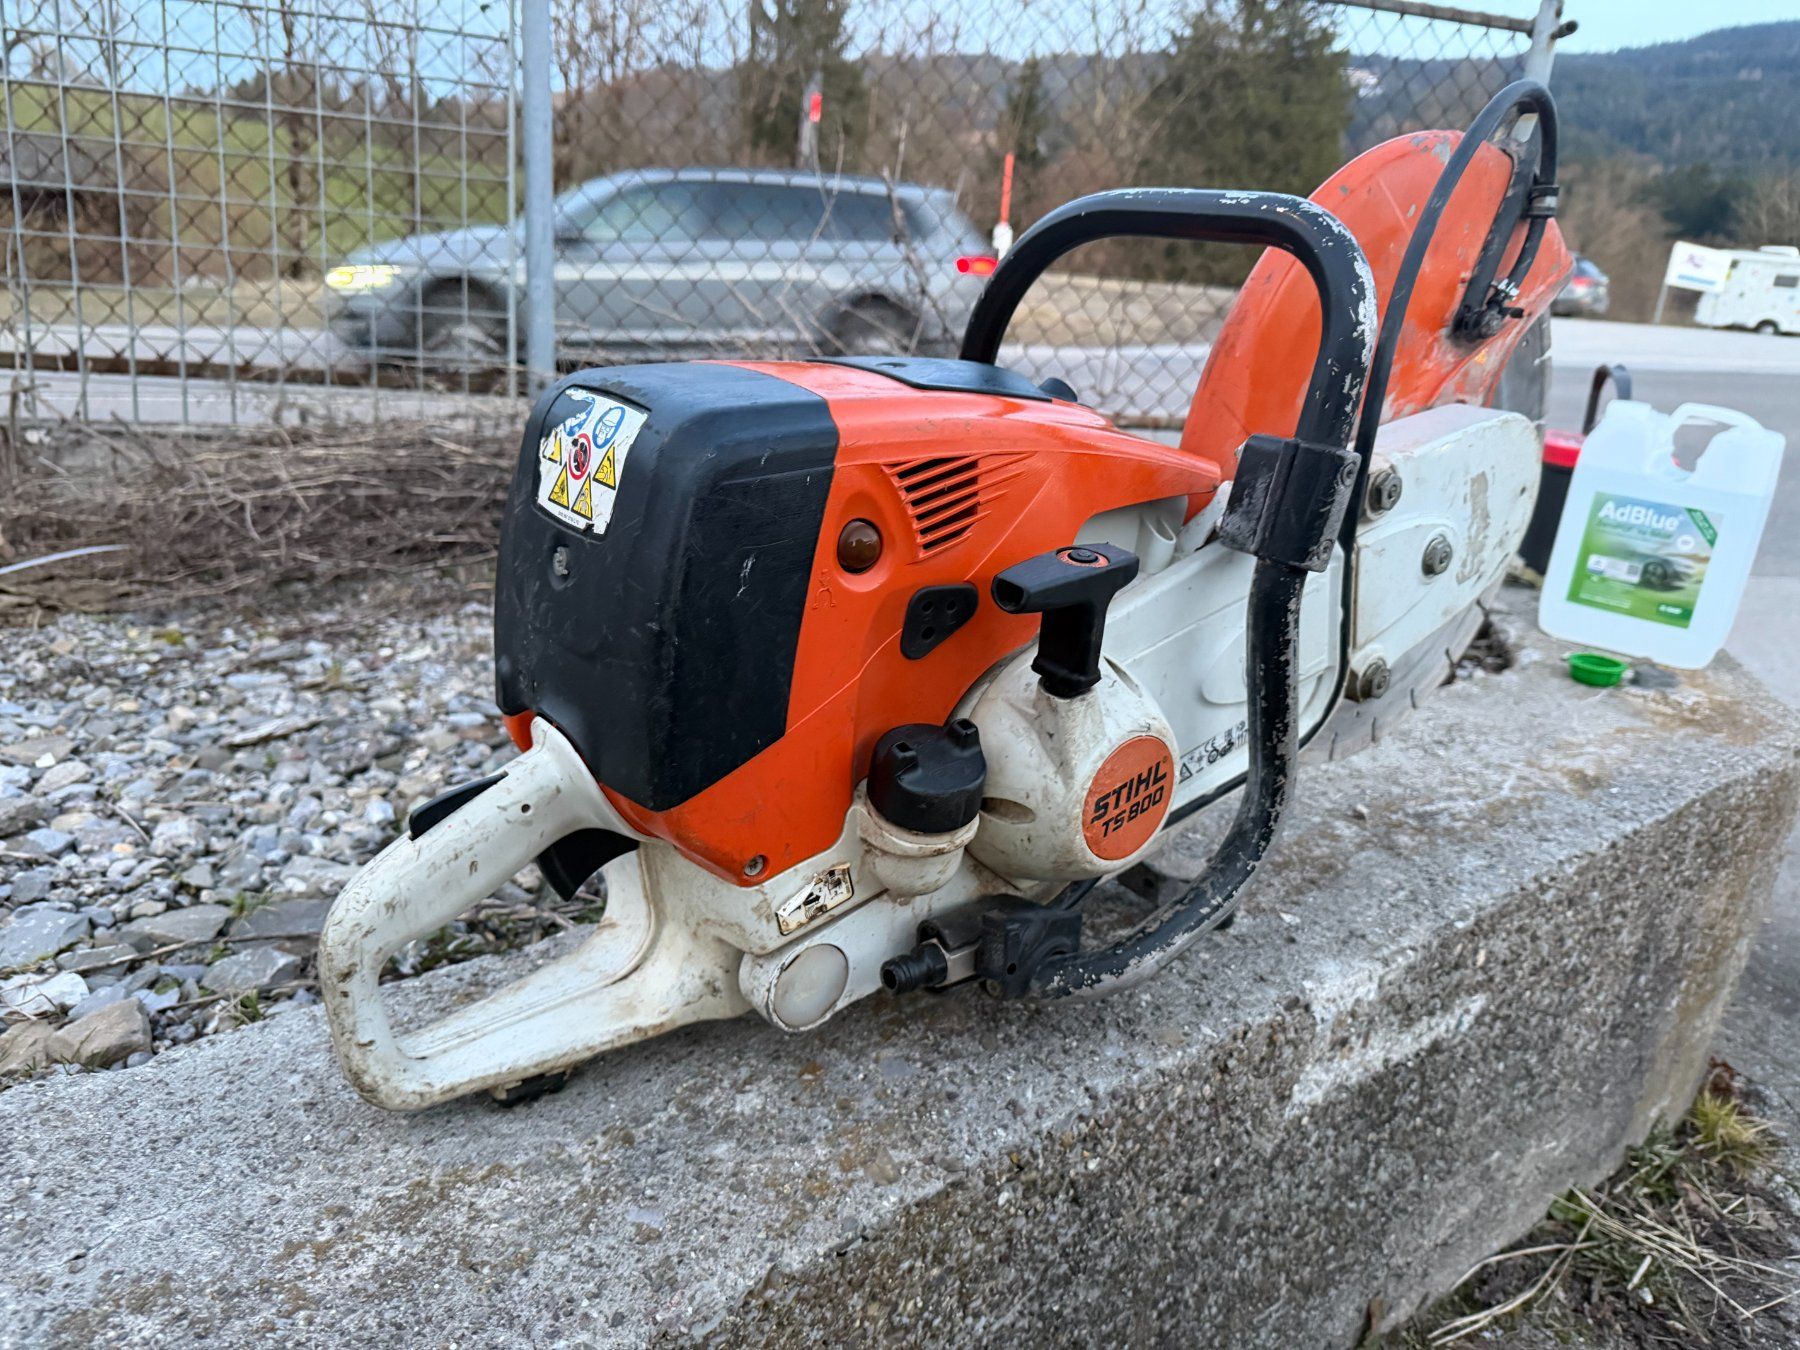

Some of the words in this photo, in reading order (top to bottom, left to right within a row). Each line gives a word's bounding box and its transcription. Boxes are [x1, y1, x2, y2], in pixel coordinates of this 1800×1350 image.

[1598, 501, 1679, 531] AdBlue
[1090, 761, 1167, 825] STIHL
[1101, 809, 1126, 838] TS
[1127, 785, 1164, 823] 800
